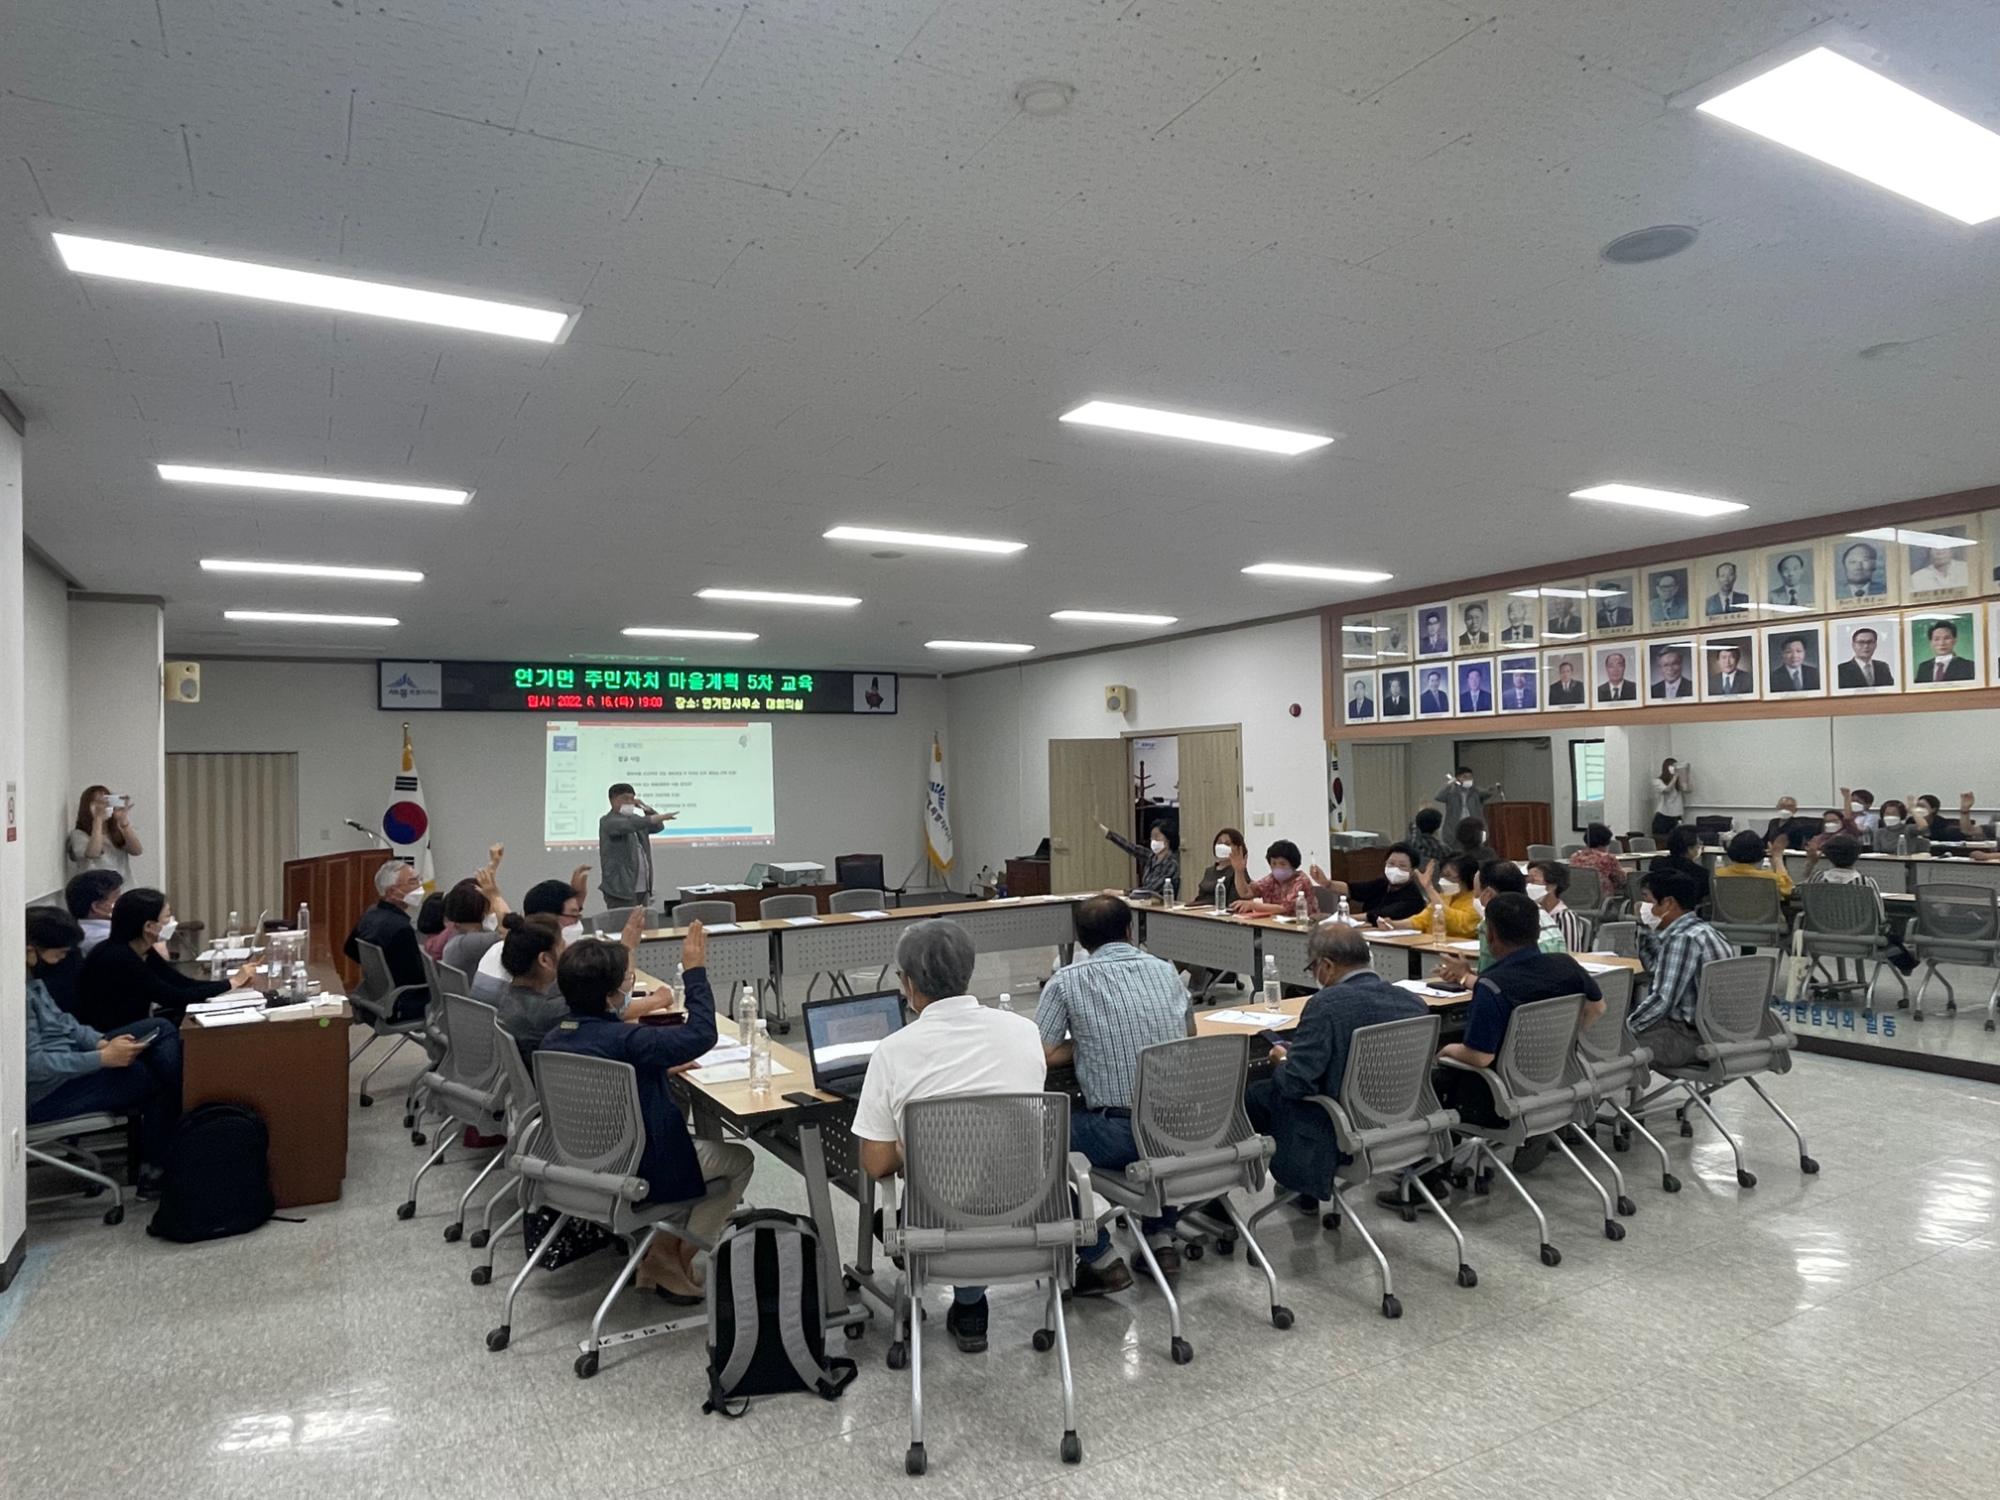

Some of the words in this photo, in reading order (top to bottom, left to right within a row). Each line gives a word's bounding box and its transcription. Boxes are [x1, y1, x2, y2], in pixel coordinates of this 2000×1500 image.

[515, 668, 574, 688] 연기면
[584, 670, 660, 690] 주민자치
[668, 672, 739, 691] 마을계획
[747, 674, 773, 691] 5차
[781, 675, 813, 692] 교육
